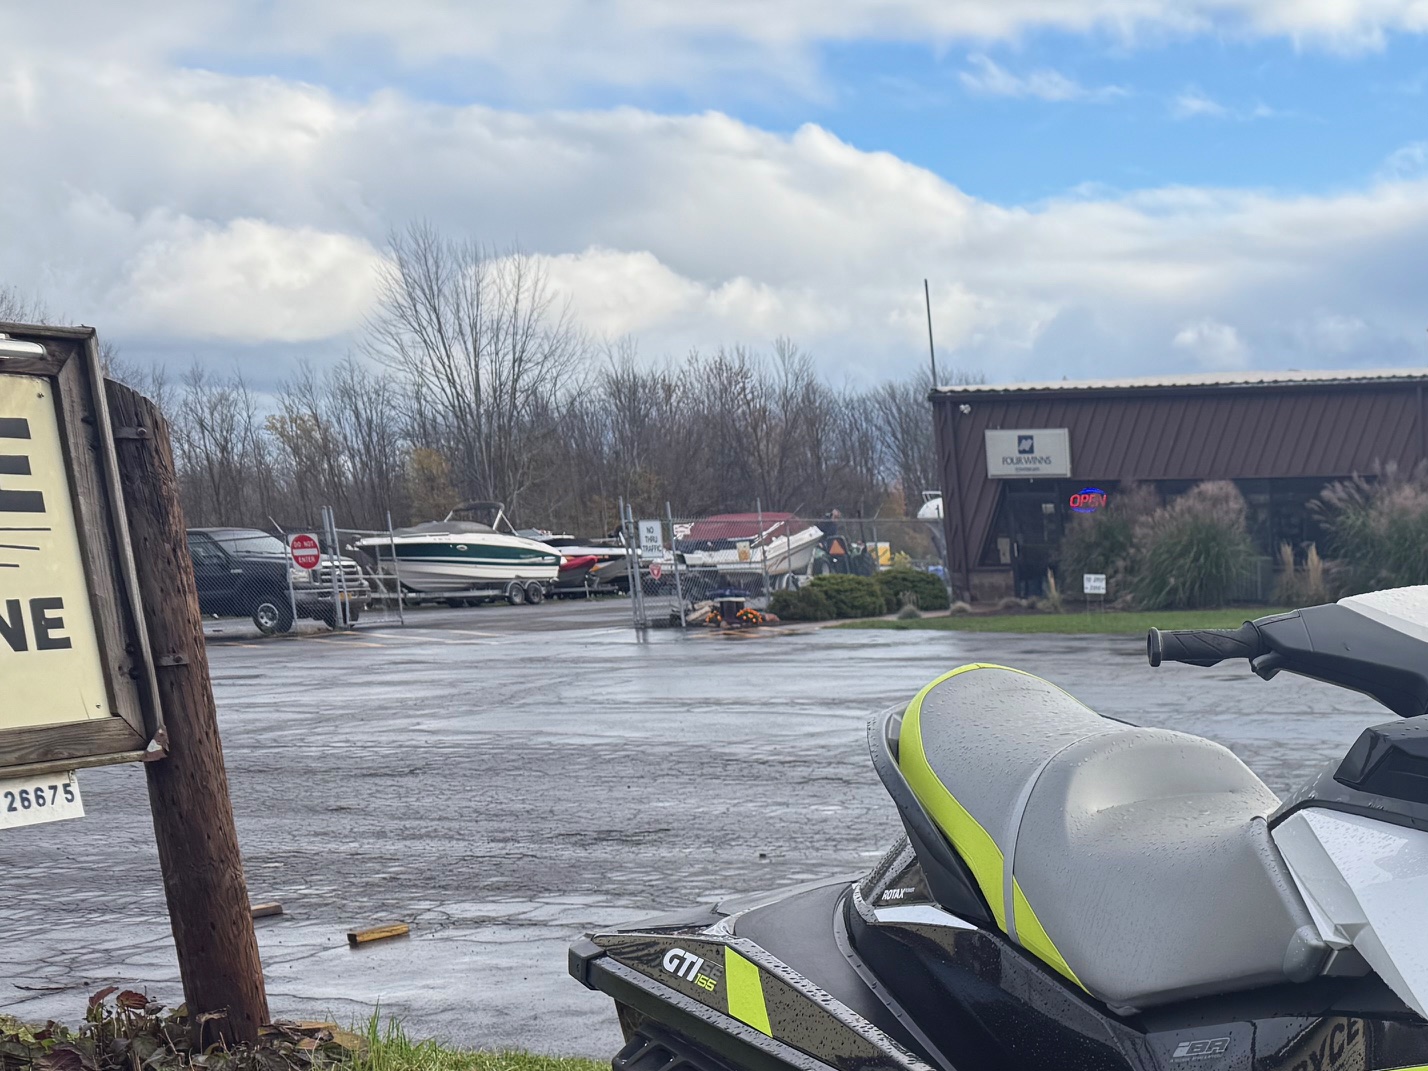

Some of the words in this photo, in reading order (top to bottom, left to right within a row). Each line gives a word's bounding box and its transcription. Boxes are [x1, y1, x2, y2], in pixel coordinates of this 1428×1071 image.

[1002, 456, 1021, 466] FOUR
[1022, 456, 1052, 465] WINNS
[1069, 494, 1107, 508] OPEN
[646, 526, 654, 534] NO
[642, 545, 662, 553] TRAFFIC
[3, 782, 75, 812] 26675
[881, 888, 905, 900] ROTAX
[663, 948, 705, 982] GTI
[694, 973, 717, 991] 155
